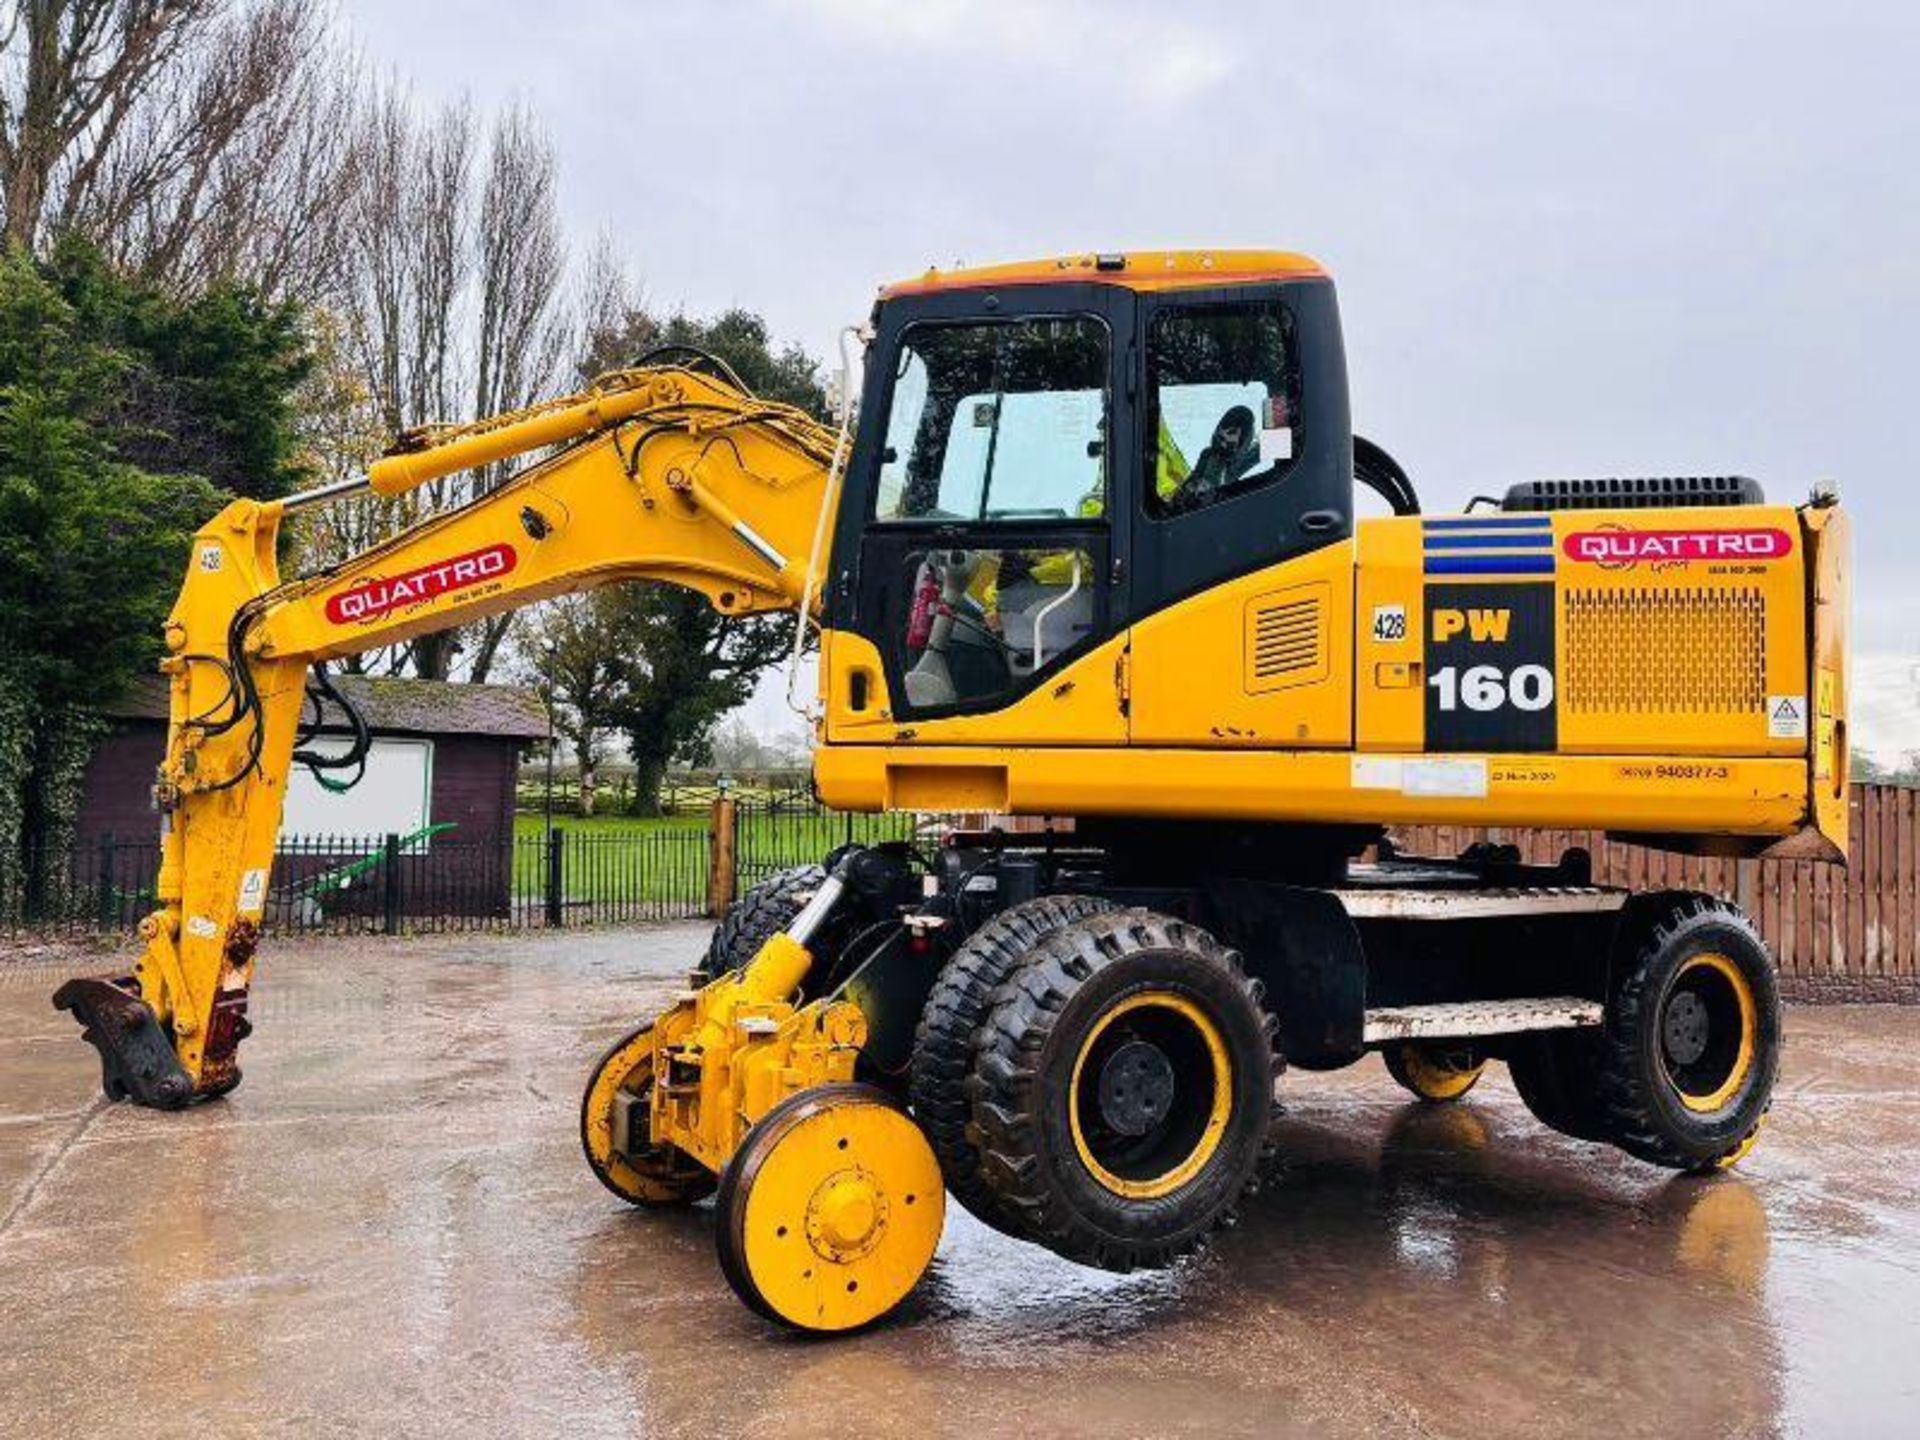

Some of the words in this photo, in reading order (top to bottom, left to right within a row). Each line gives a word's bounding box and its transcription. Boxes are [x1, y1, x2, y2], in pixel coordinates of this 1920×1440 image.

[1581, 534, 1775, 560] QUATTRO
[340, 550, 505, 618] QUATTRO
[1374, 613, 1405, 639] 428
[1432, 608, 1511, 642] PW
[1428, 664, 1554, 711] 160
